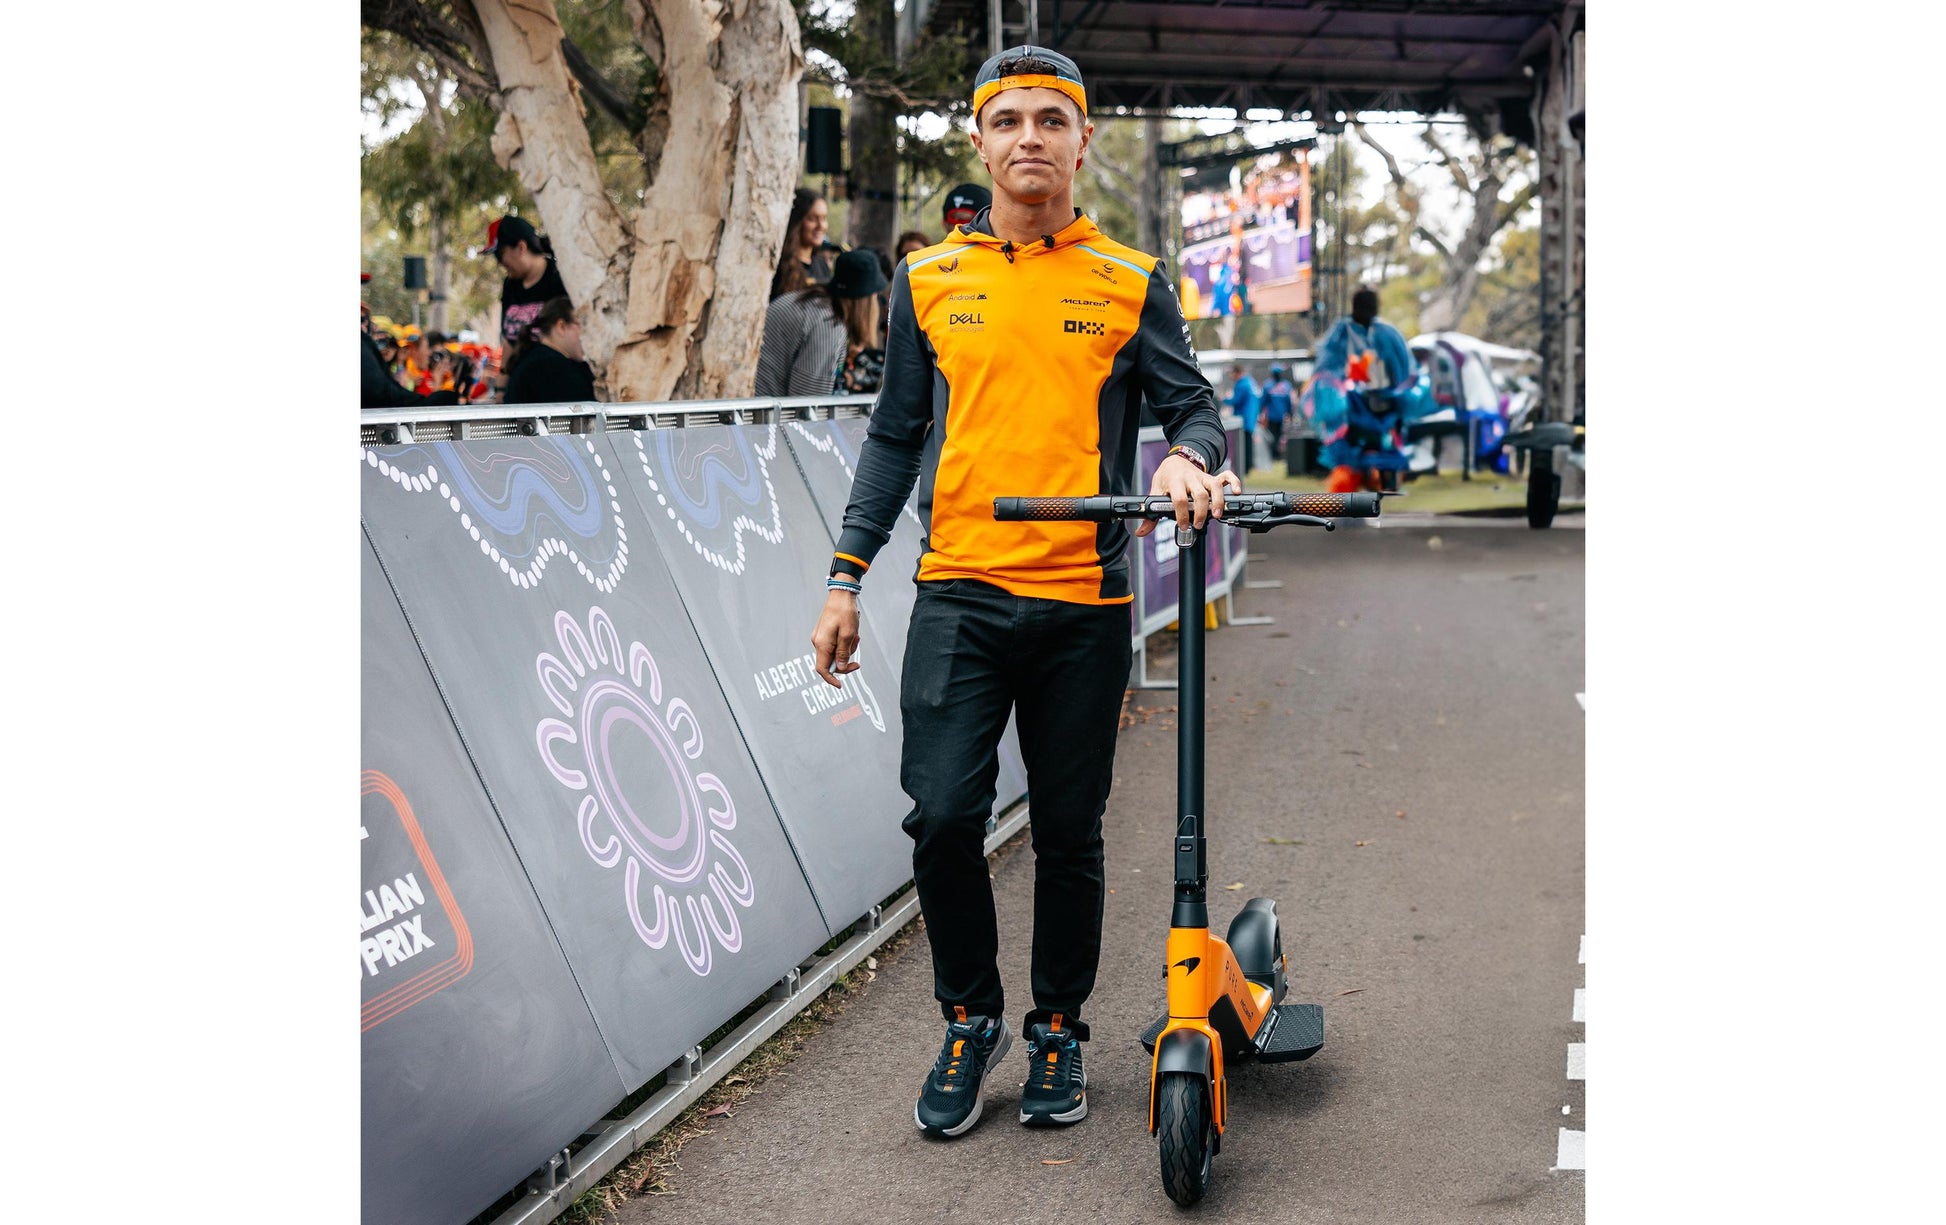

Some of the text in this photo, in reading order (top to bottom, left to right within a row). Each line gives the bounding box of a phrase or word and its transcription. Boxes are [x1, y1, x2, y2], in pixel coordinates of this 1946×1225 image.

[949, 313, 985, 325] DELL
[1060, 298, 1110, 308] McLaren
[1064, 320, 1105, 336] OKX
[753, 656, 808, 701] ALBERT
[801, 672, 853, 716] CIRCUIT
[361, 872, 426, 932] LIAN
[361, 914, 436, 977] PRIX
